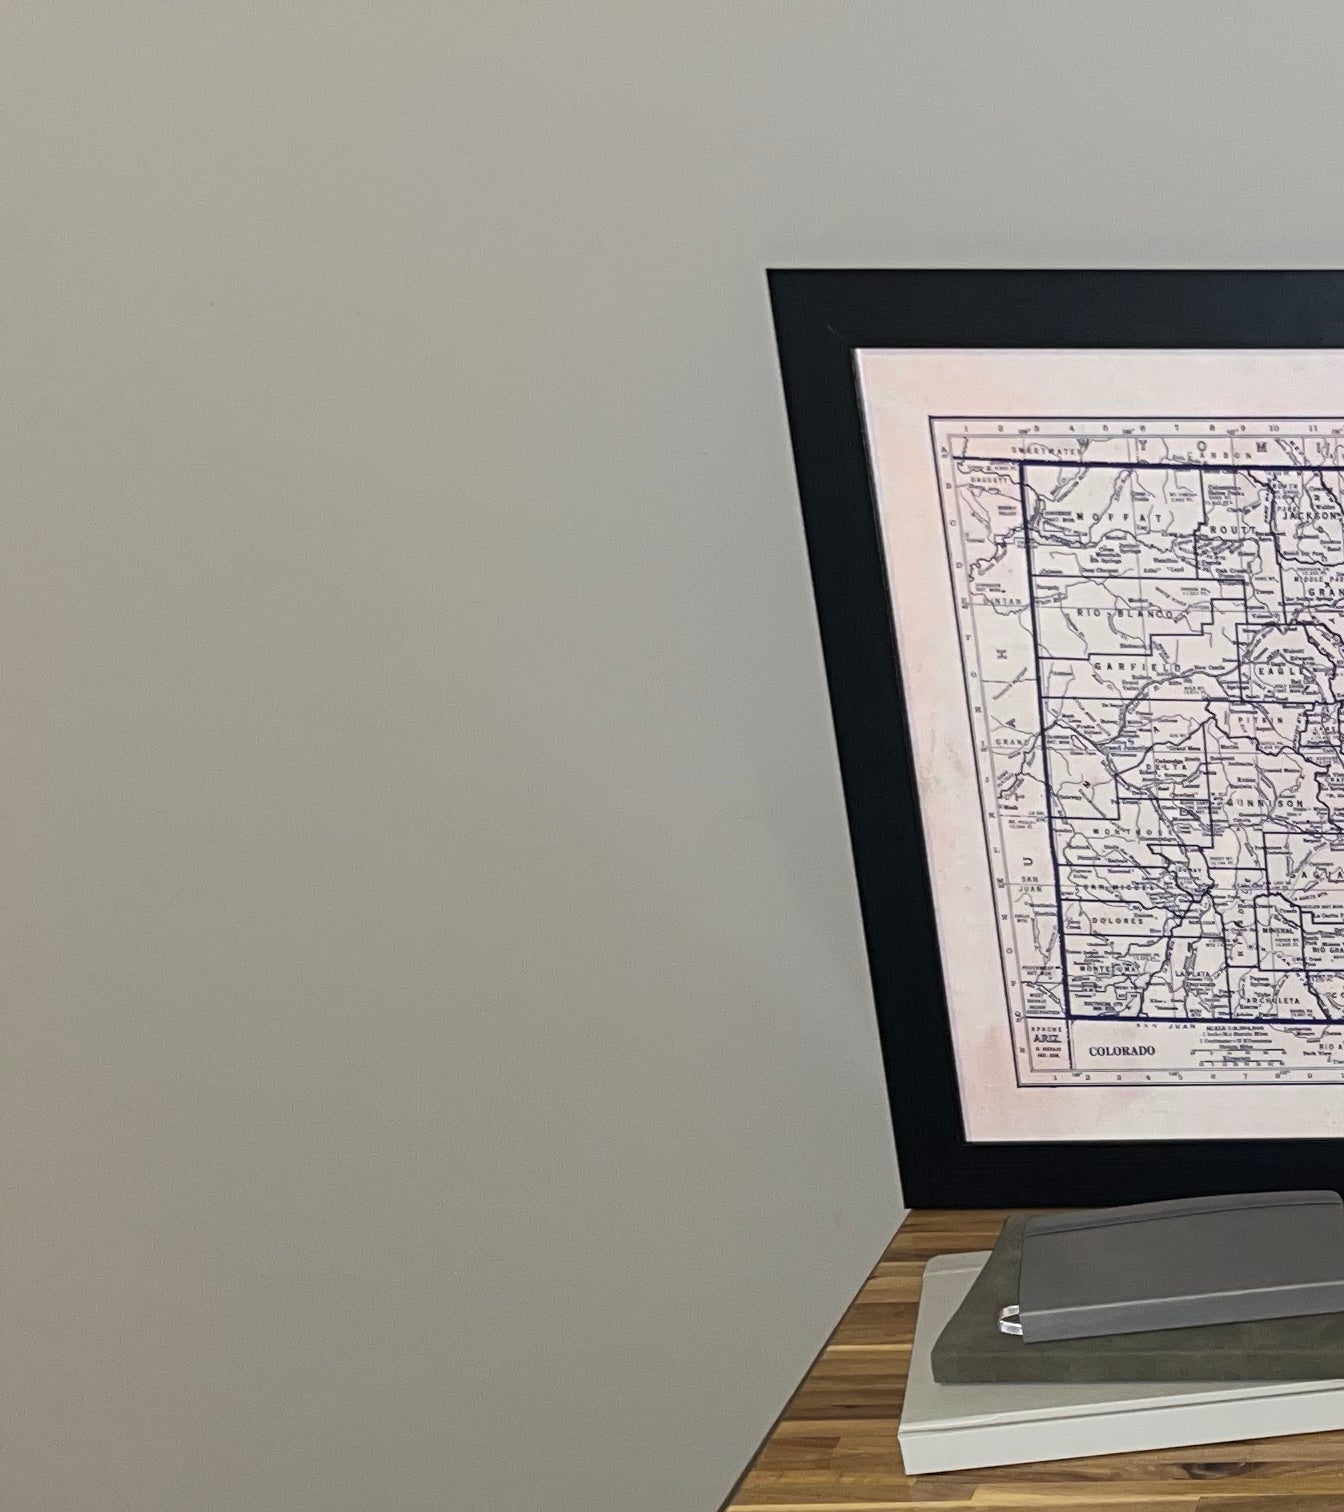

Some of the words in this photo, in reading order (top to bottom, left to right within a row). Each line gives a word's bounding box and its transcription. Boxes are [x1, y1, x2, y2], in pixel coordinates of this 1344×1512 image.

[1076, 512, 1162, 523] MOFFAT
[1282, 512, 1336, 520] JACKSON
[1210, 526, 1256, 535] ROUTT
[1077, 608, 1100, 617] RIO
[1118, 609, 1173, 619] BLANCO
[1095, 662, 1181, 672] GARFIELD
[1259, 667, 1305, 676] EAGLE
[1146, 763, 1187, 771] DELTA
[1226, 799, 1303, 808] GUNNISON
[1093, 828, 1172, 836] MONTROSE
[1092, 917, 1144, 925] DOLORES
[1089, 1046, 1156, 1057] COLORADO
